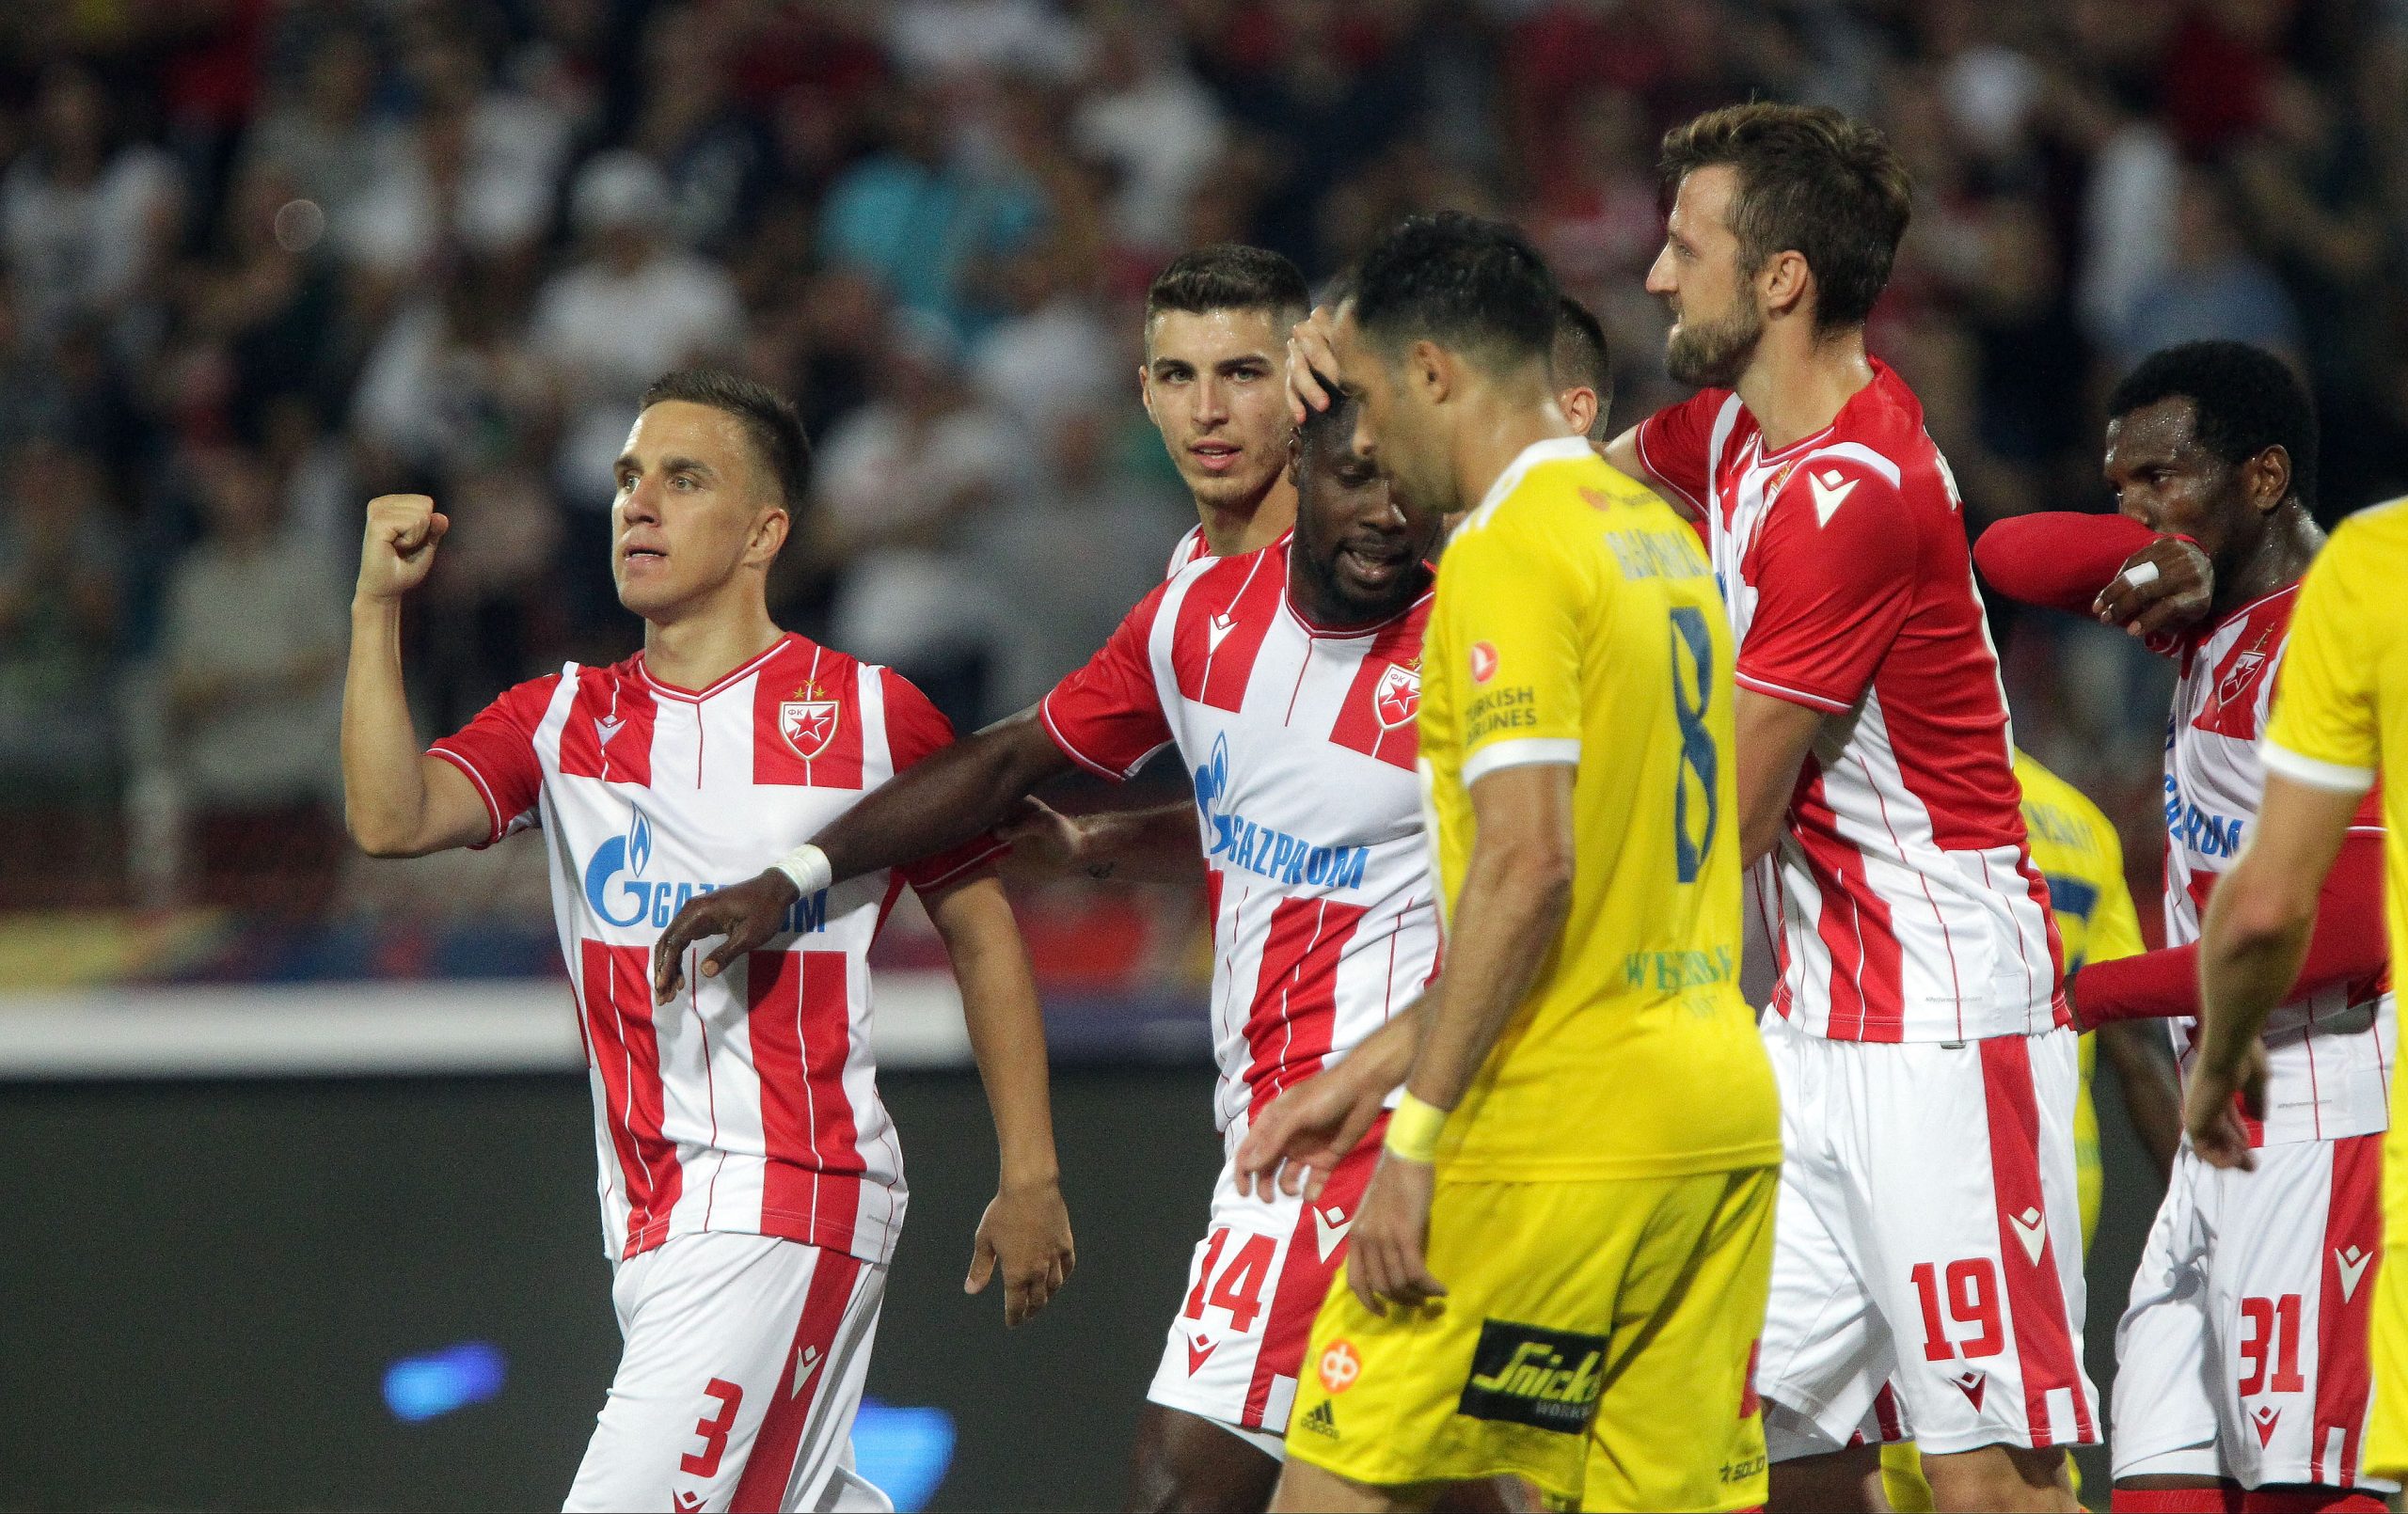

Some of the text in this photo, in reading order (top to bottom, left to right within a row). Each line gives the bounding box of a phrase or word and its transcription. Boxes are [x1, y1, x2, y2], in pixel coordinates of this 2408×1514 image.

[1668, 606, 1718, 883] 8
[1228, 814, 1370, 890] GAZPROM
[1183, 1226, 1279, 1333] 14
[1910, 1257, 2005, 1362] 19
[2239, 1293, 2305, 1397] 31
[679, 1377, 744, 1478] 3
